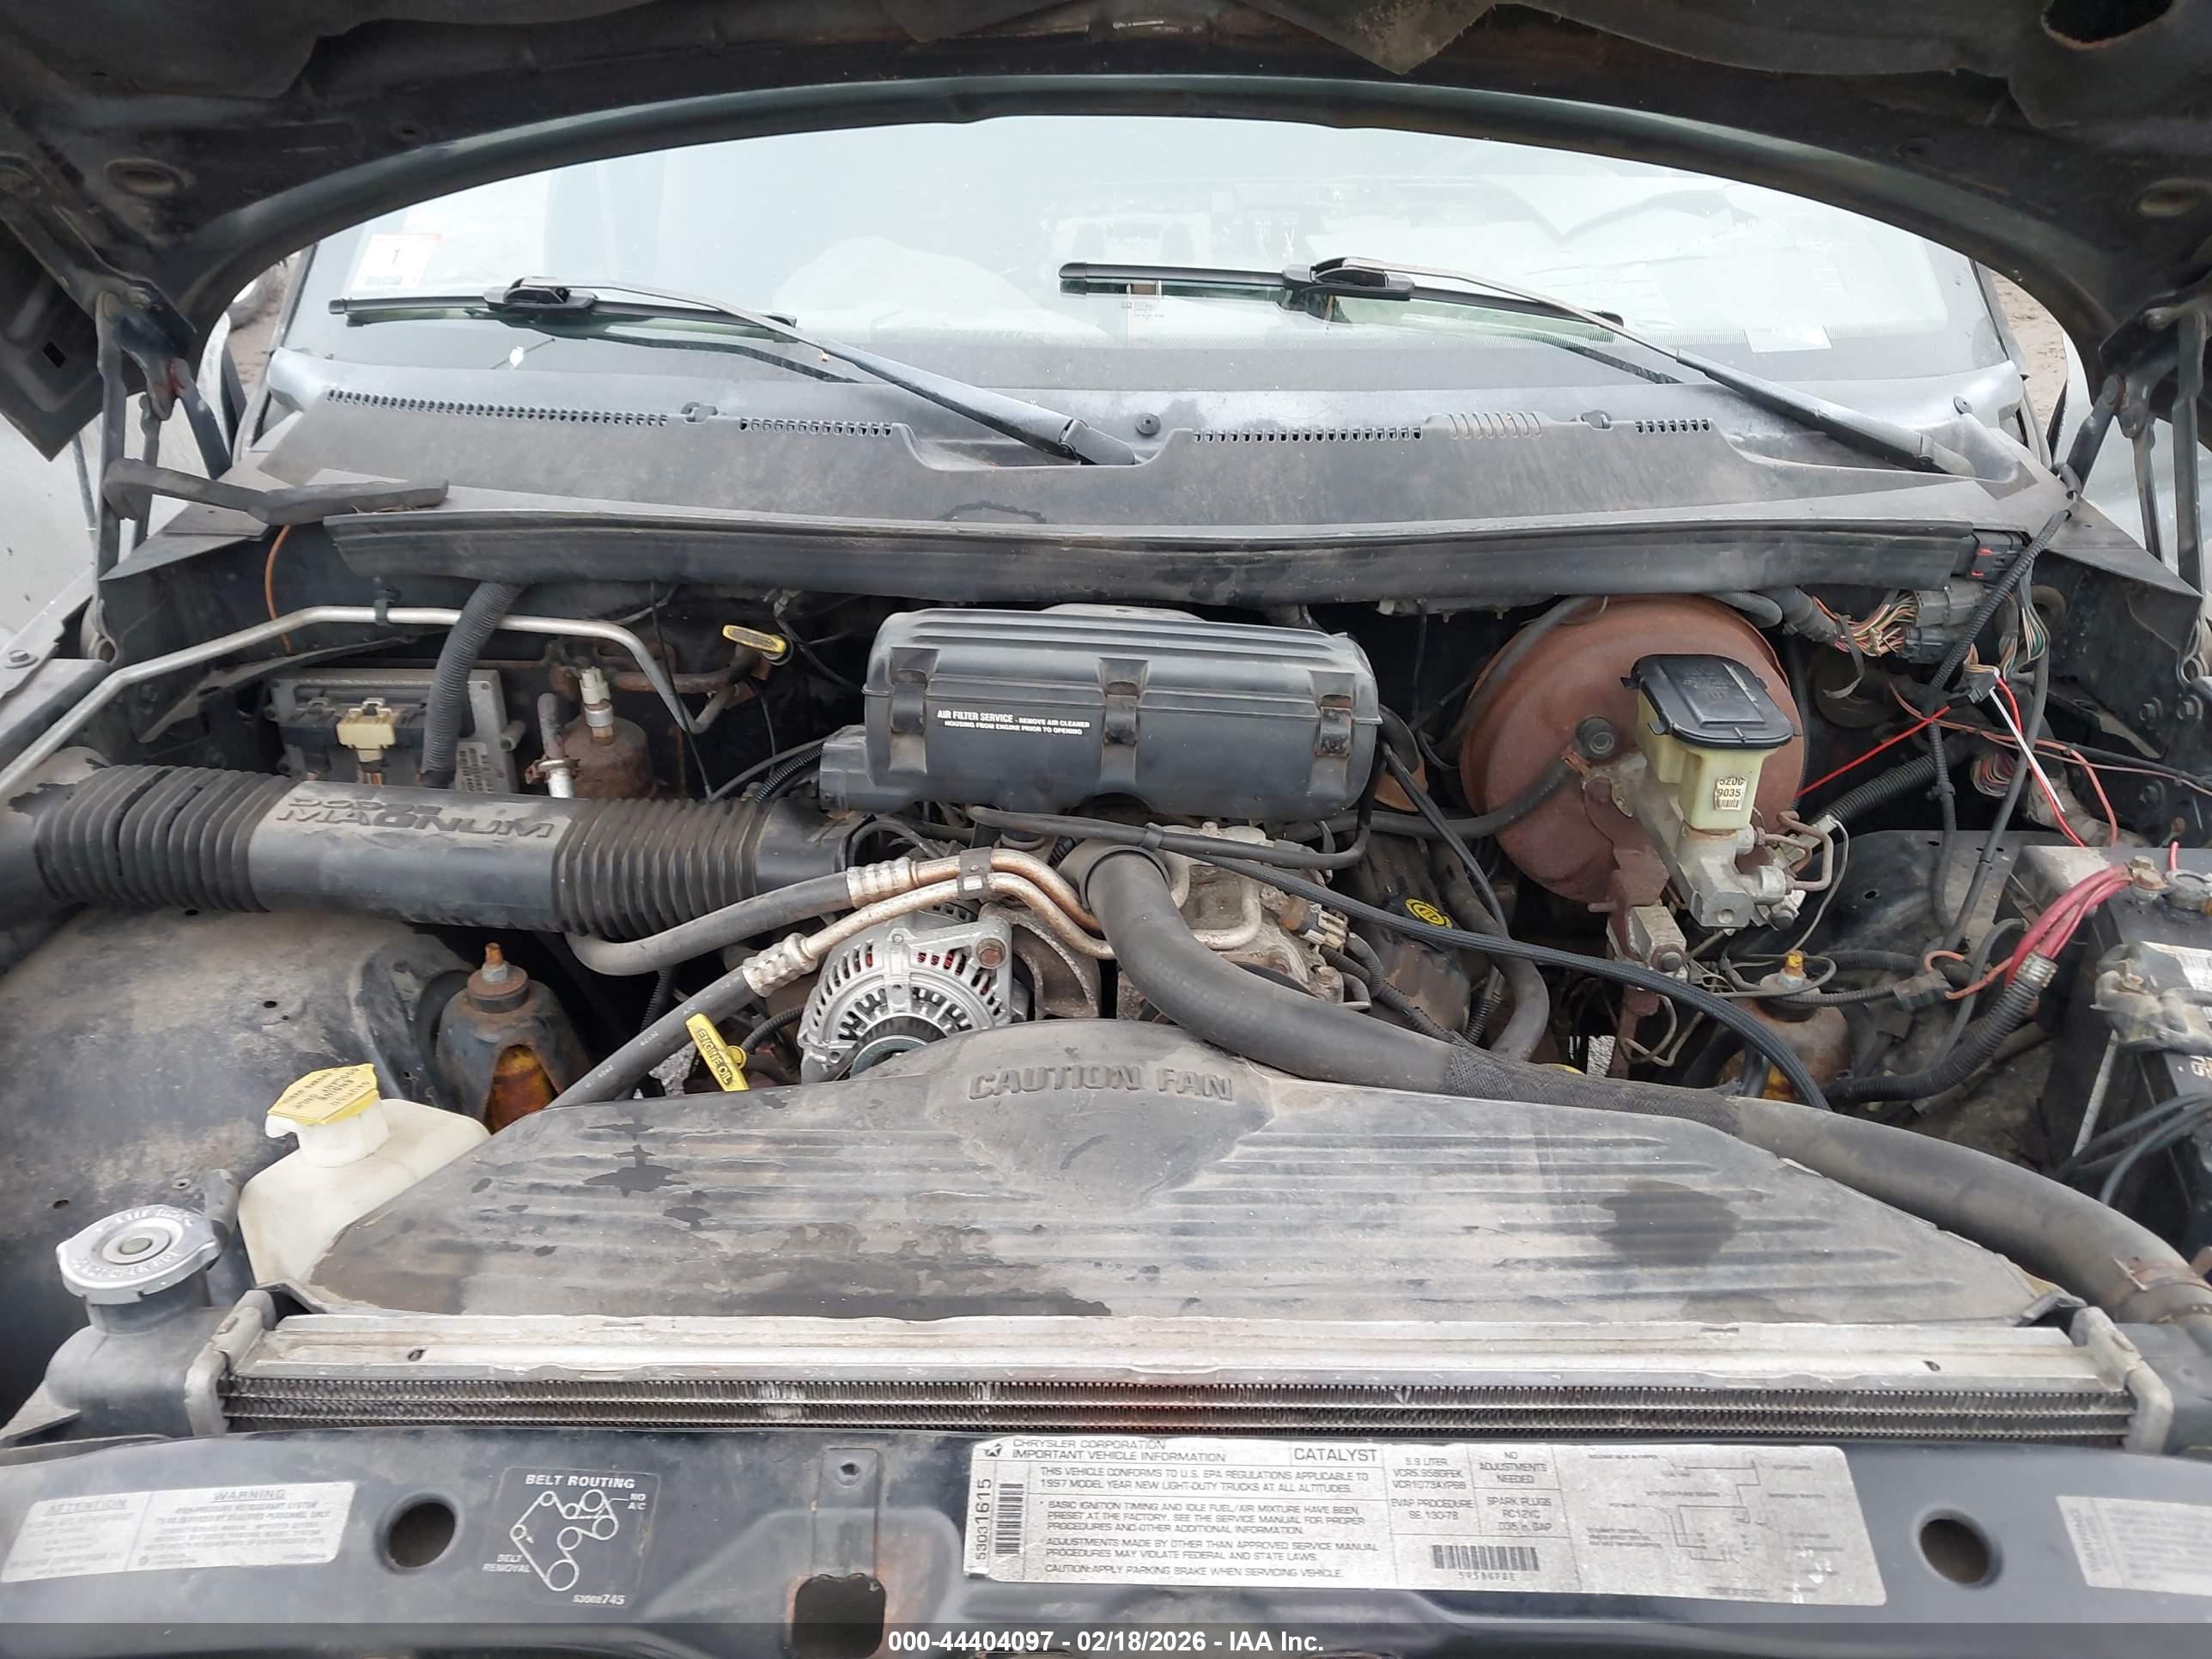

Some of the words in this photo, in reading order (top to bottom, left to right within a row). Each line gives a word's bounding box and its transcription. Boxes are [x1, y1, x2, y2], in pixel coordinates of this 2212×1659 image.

[937, 710, 951, 719] AIR
[953, 711, 979, 721] FILTER
[980, 713, 1013, 723] SERVICE
[1717, 788, 1741, 797] 9035
[276, 808, 555, 839] MAGNUM
[697, 1030, 724, 1066] ENGINE
[718, 1066, 732, 1085] OIL
[969, 1066, 1142, 1100] CAUTION
[1158, 1068, 1233, 1103] FAN
[1013, 1439, 1076, 1449] CHRYSLER
[1080, 1440, 1166, 1450] CORPORATION
[1012, 1449, 1087, 1459] IMPORTANT
[1089, 1451, 1137, 1461] VEHICLE
[1141, 1452, 1226, 1462] INFORMATION
[1294, 1448, 1377, 1462] CATALYST
[1504, 1452, 1518, 1460] NO
[1423, 1458, 1449, 1466] LITER
[1480, 1462, 1547, 1472] ADJUSTMENTS
[1041, 1467, 1062, 1476] THIS
[1066, 1468, 1104, 1477] VEHICLE
[1107, 1468, 1162, 1478] CONFORMS
[1166, 1469, 1178, 1478] TO
[1181, 1469, 1199, 1479] U.S.
[1204, 1470, 1222, 1479] EPA
[1225, 1470, 1292, 1480] REGULATIONS
[1295, 1471, 1353, 1481] APPLICABLE
[1357, 1473, 1369, 1481] TO
[1497, 1475, 1534, 1484] NEEDED
[525, 1474, 564, 1486] BELT
[567, 1475, 636, 1489] ROUTING
[1041, 1479, 1066, 1488] 1997
[1070, 1480, 1105, 1489] MODEL
[1107, 1480, 1132, 1489] YEAR
[1134, 1481, 1159, 1489] NEW
[1162, 1481, 1217, 1491] LIGHT-DUTY
[1220, 1482, 1259, 1492] TRUCKS
[1263, 1483, 1274, 1492] AT
[1278, 1483, 1295, 1492] ALL
[1298, 1484, 1353, 1493] ALTITUDES.
[215, 1489, 286, 1501] WARNING
[629, 1493, 647, 1501] NO
[1486, 1496, 1519, 1506] SPARK
[1519, 1497, 1552, 1506] PLUGS
[627, 1502, 647, 1510] A/C
[1048, 1501, 1076, 1510] BASIC
[1079, 1502, 1121, 1510] IGNITION
[1124, 1503, 1158, 1511] TIMING
[1160, 1503, 1183, 1511] AND
[1209, 1504, 1254, 1513] FUEL/AIR
[1258, 1505, 1301, 1514] MIXTURE
[1304, 1506, 1330, 1514] HAVE
[1333, 1506, 1358, 1515] BEEN
[1391, 1498, 1415, 1507] EVAP
[1417, 1499, 1474, 1508] PROCEDURE
[975, 1479, 991, 1560] 53031615
[1047, 1511, 1084, 1520] PRESET
[1087, 1512, 1100, 1520] AT
[1103, 1513, 1121, 1521] THE
[1123, 1513, 1170, 1522] FACTORY.
[1173, 1514, 1191, 1522] SEE
[1194, 1514, 1212, 1522] THE
[1216, 1515, 1255, 1523] SERVICE
[1258, 1516, 1301, 1524] MANUAL
[1326, 1517, 1365, 1525] PROPER
[1047, 1522, 1112, 1531] PROCEDURES
[1115, 1523, 1136, 1531] AND
[1139, 1524, 1171, 1532] OTHER
[1174, 1525, 1231, 1534] ADDITIONAL
[1235, 1526, 1305, 1535] INFORMATION.
[1532, 1522, 1552, 1532] GAP
[1046, 1537, 1118, 1547] ADJUSTMENTS
[1122, 1539, 1151, 1547] MADE
[1171, 1540, 1202, 1548] OTHER
[1207, 1540, 1233, 1549] THAN
[1237, 1541, 1288, 1550] APPROVED
[1291, 1542, 1332, 1551] SERVICE
[1335, 1543, 1379, 1552] MANUAL
[496, 1554, 523, 1563] BELT
[1046, 1548, 1111, 1558] PROCEDURES
[1115, 1550, 1136, 1558] MAY
[1140, 1550, 1179, 1559] VIOLATE
[1183, 1551, 1226, 1560] FEDERAL
[1229, 1552, 1251, 1560] AND
[1254, 1553, 1284, 1561] STATE
[1287, 1553, 1318, 1562] LAWS.
[482, 1563, 532, 1573] REMOVAL
[1126, 1566, 1170, 1575] PARKING
[1174, 1567, 1206, 1576] BRAKE
[1210, 1568, 1242, 1576] WHEN
[1245, 1568, 1297, 1577] SERVICING
[1300, 1569, 1343, 1578] VEHICLE.
